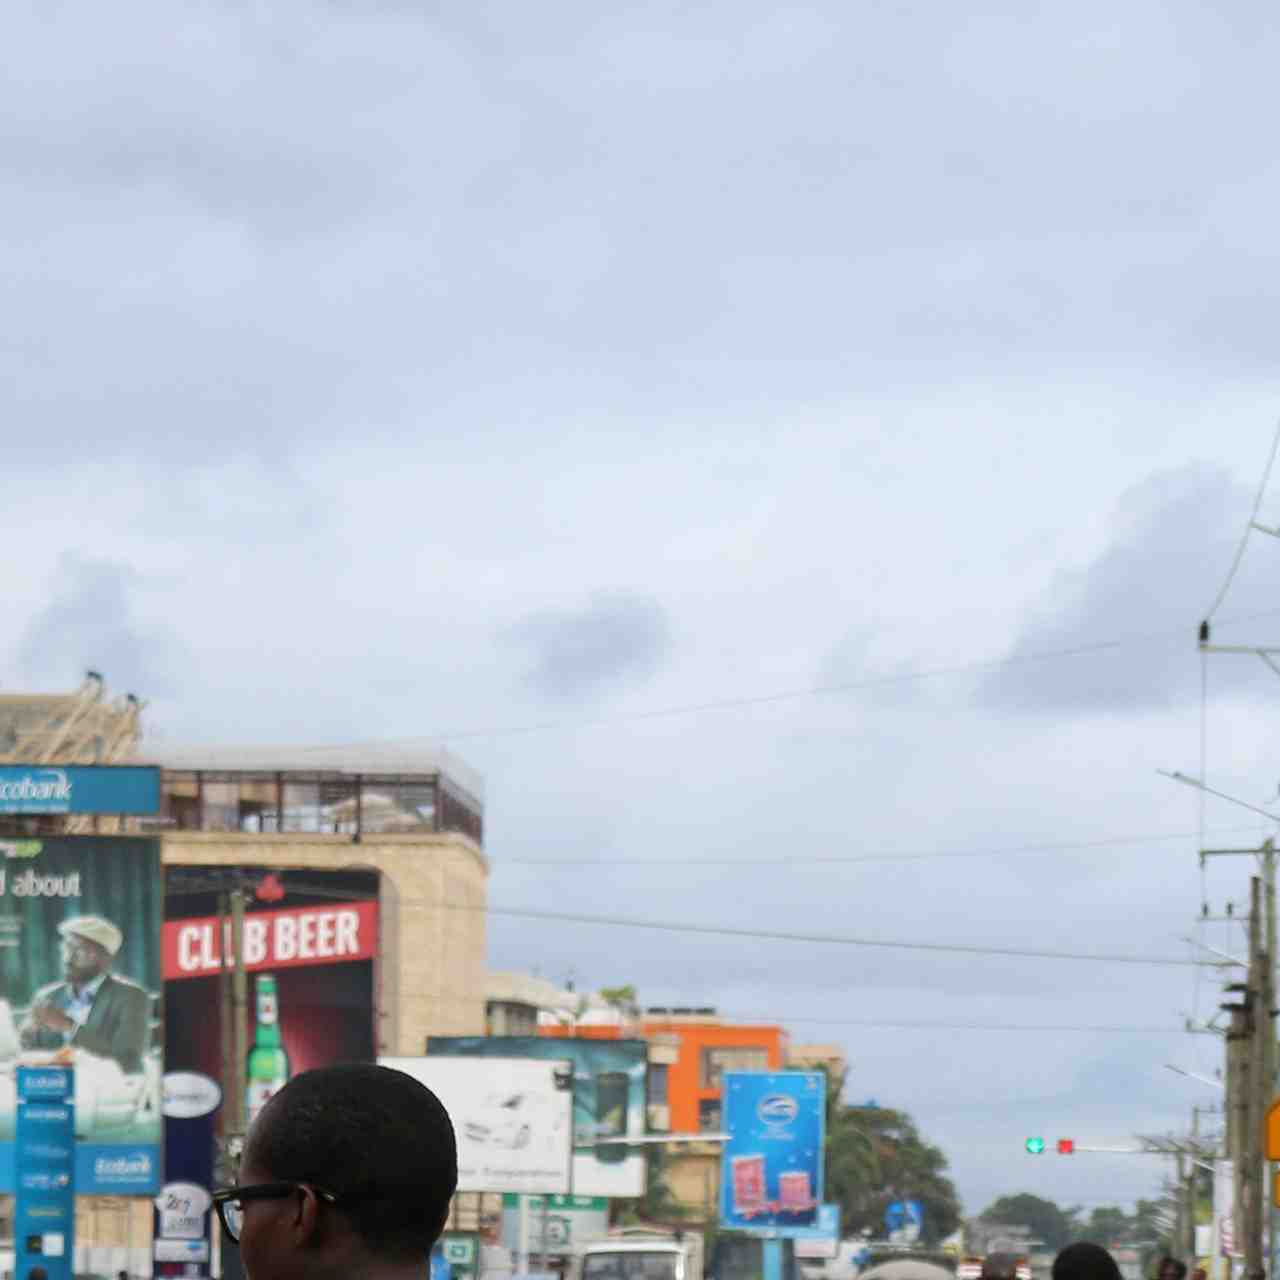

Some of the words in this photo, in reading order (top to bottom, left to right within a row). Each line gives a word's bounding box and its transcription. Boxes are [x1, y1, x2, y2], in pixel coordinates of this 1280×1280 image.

[0, 770, 73, 800] cobank
[12, 870, 81, 897] about
[273, 908, 360, 961] BEER
